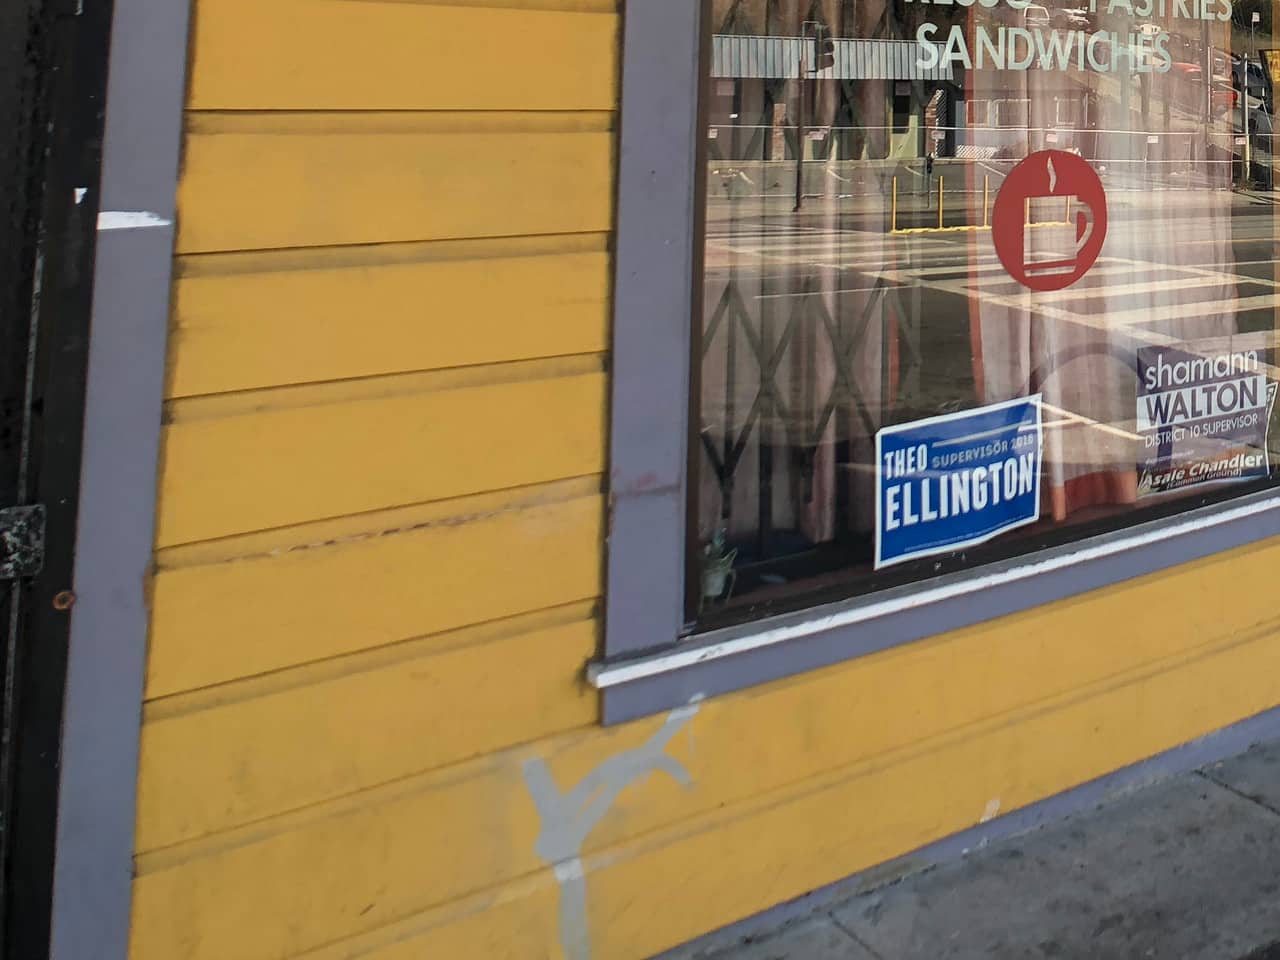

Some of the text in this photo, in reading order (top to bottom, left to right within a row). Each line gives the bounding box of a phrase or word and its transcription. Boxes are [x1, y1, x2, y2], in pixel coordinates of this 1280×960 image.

[915, 22, 1173, 74] SANDWICHES
[1145, 350, 1258, 390] shamann
[1146, 376, 1258, 427] WALTON
[1145, 413, 1258, 448] DISTRICT 10 SUPERVISOR
[884, 443, 928, 480] THEO
[931, 439, 1008, 469] SUPERVISOR
[1189, 453, 1263, 476] Chandler
[886, 451, 1034, 531] ELLINGTON
